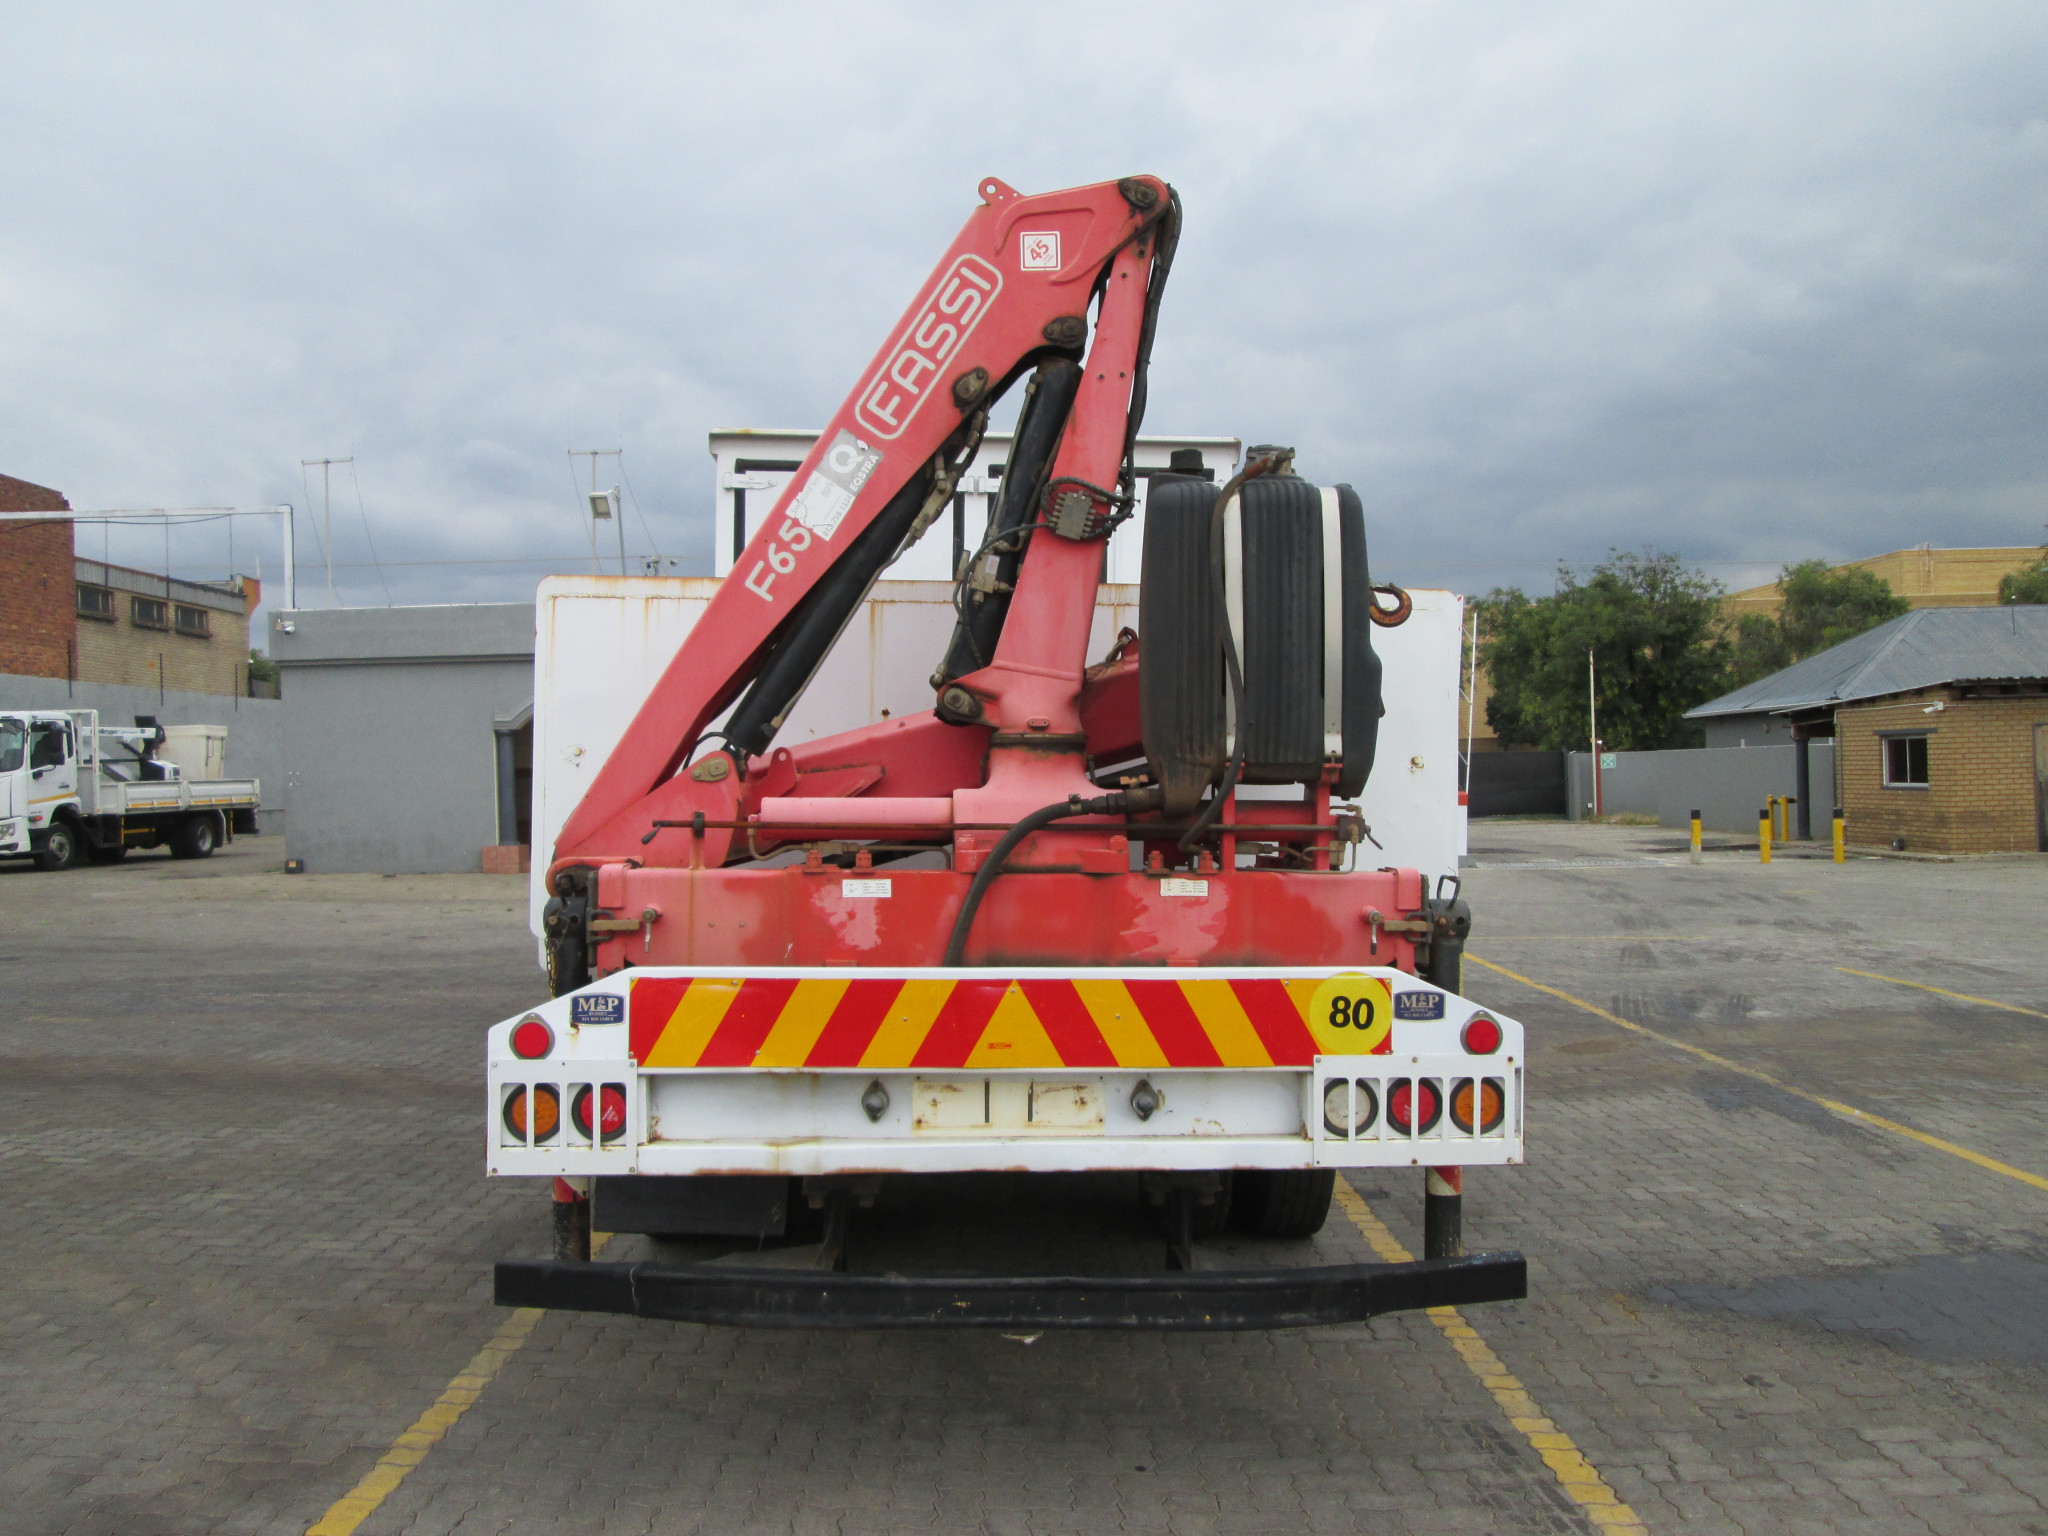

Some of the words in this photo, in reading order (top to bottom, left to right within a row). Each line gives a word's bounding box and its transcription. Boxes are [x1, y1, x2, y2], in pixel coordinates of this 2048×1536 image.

[1031, 240, 1049, 261] 45
[866, 266, 992, 427] FASSI
[849, 455, 879, 491] EQSTRA
[822, 523, 834, 537] 013
[745, 519, 811, 602] F65
[578, 997, 618, 1011] M&P
[1329, 996, 1374, 1030] 80
[1400, 994, 1439, 1008] M&P
